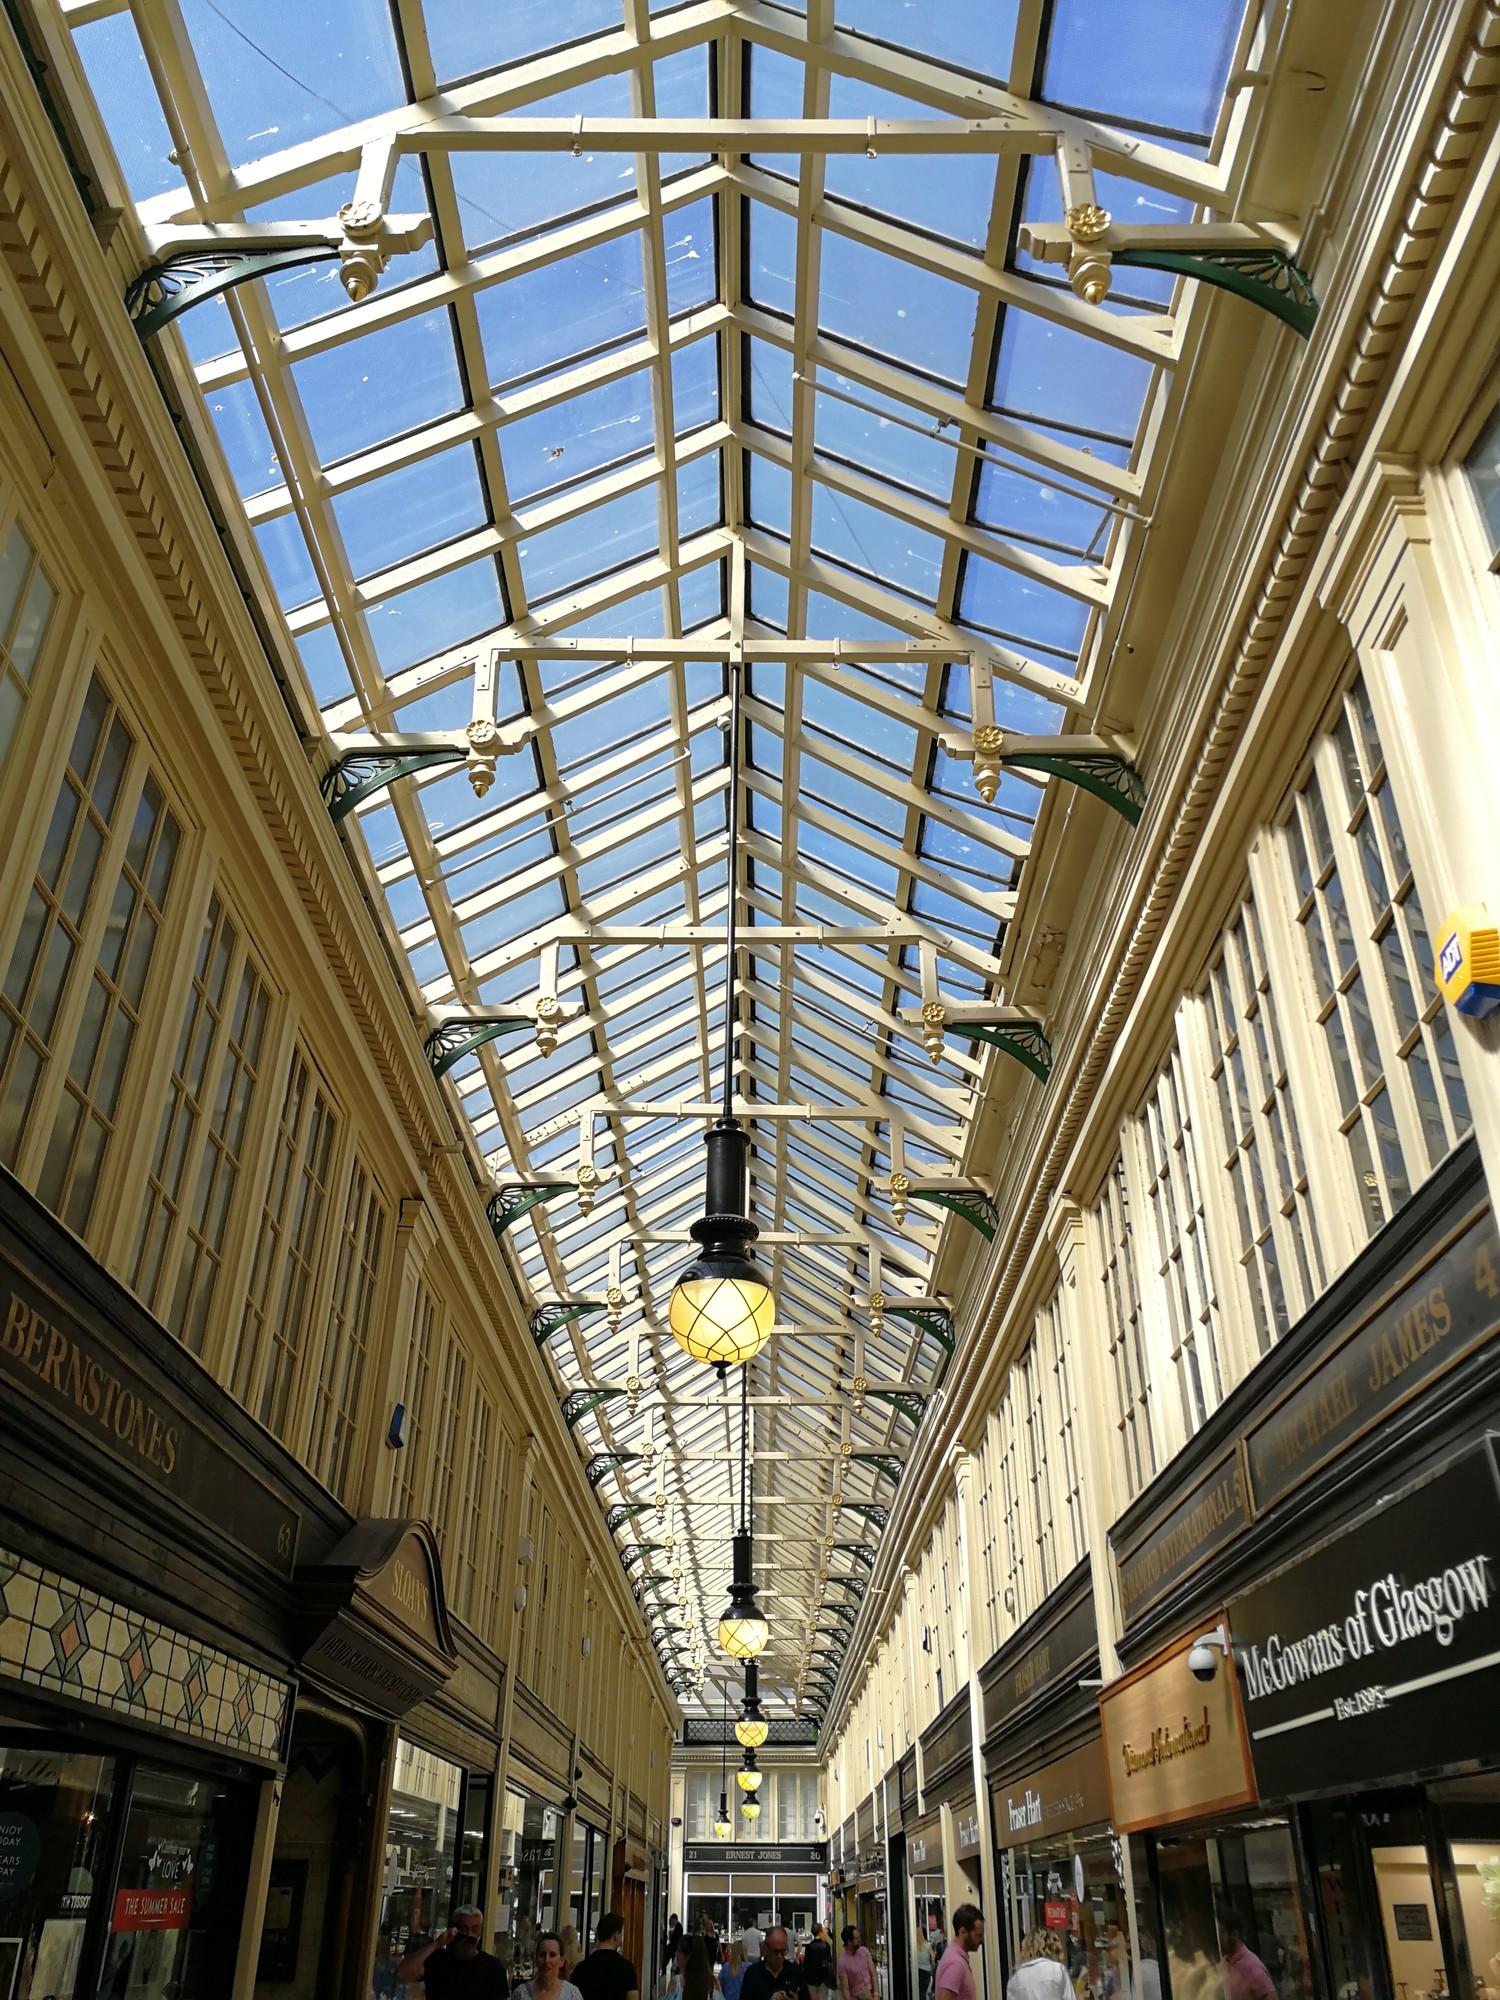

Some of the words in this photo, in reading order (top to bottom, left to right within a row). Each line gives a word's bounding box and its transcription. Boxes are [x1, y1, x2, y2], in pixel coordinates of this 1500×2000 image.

[0, 1291, 178, 1474] BERNSTONES
[1278, 1375, 1359, 1470] MICHAEL
[1369, 1284, 1452, 1392] JAMES
[1159, 1480, 1235, 1574] INTERNATIONAL
[1241, 1624, 1345, 1701] McGowans
[1345, 1589, 1374, 1660] of
[1370, 1554, 1492, 1647] Glasgow
[1008, 1798, 1026, 1831] Fraser
[1026, 1790, 1042, 1824] Hart
[161, 1861, 180, 1879] LOVE
[688, 1851, 697, 1859] 21
[725, 1850, 755, 1860] ERNEST
[757, 1850, 782, 1860] JONES
[125, 1897, 139, 1915] THE
[140, 1897, 168, 1915] SUMMER
[169, 1897, 186, 1915] SALE
